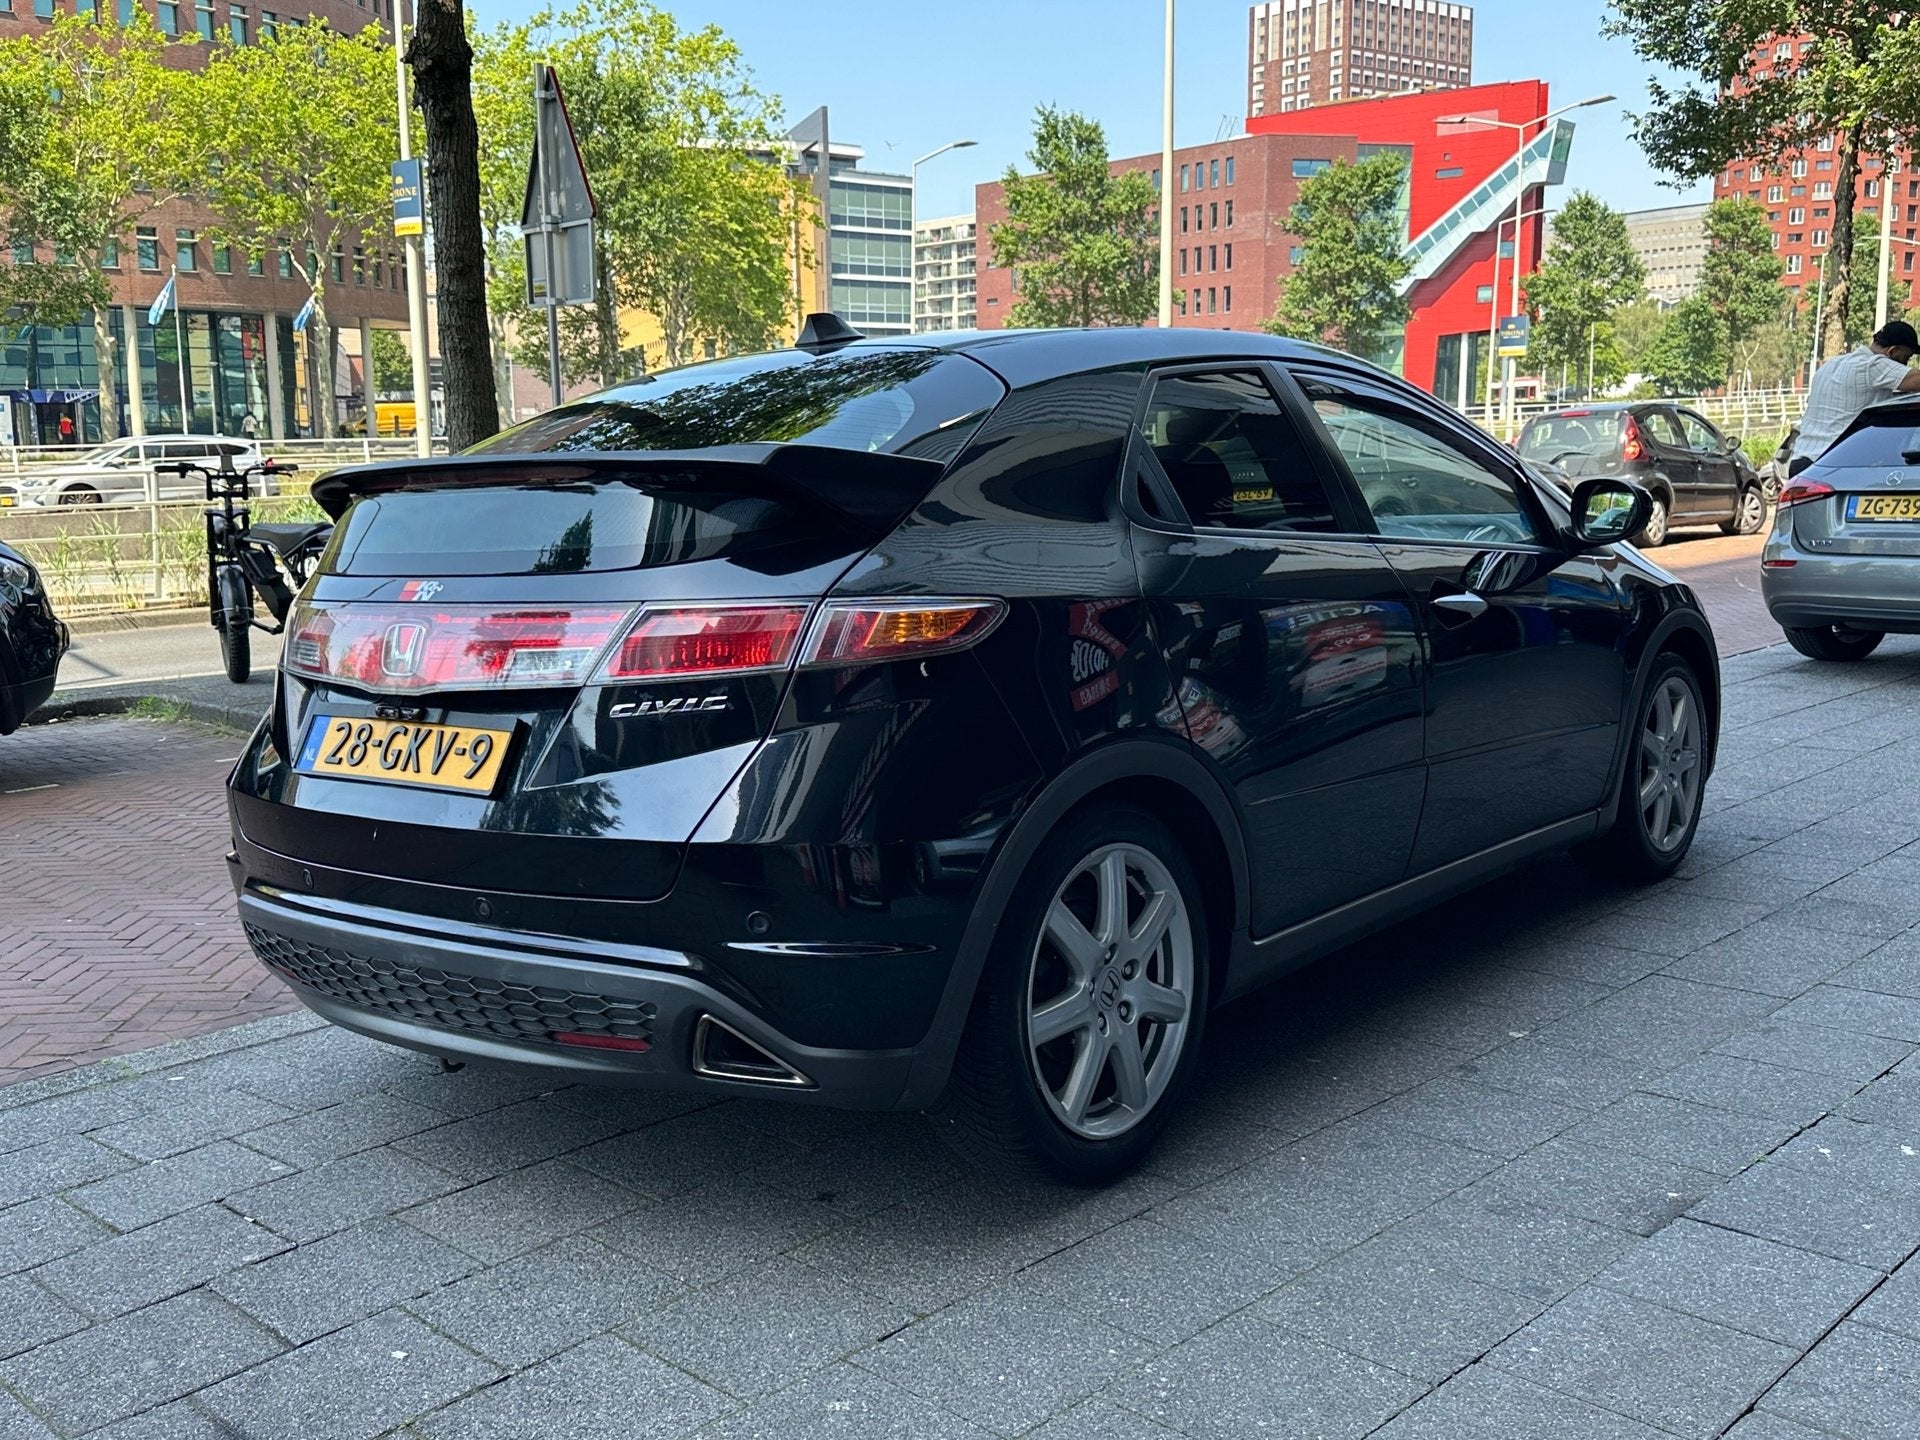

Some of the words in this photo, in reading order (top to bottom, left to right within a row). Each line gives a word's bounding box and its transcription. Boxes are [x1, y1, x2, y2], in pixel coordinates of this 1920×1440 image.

[609, 695, 729, 720] CIVIC
[302, 747, 314, 761] NL
[324, 721, 493, 779] 28-GKV-9
